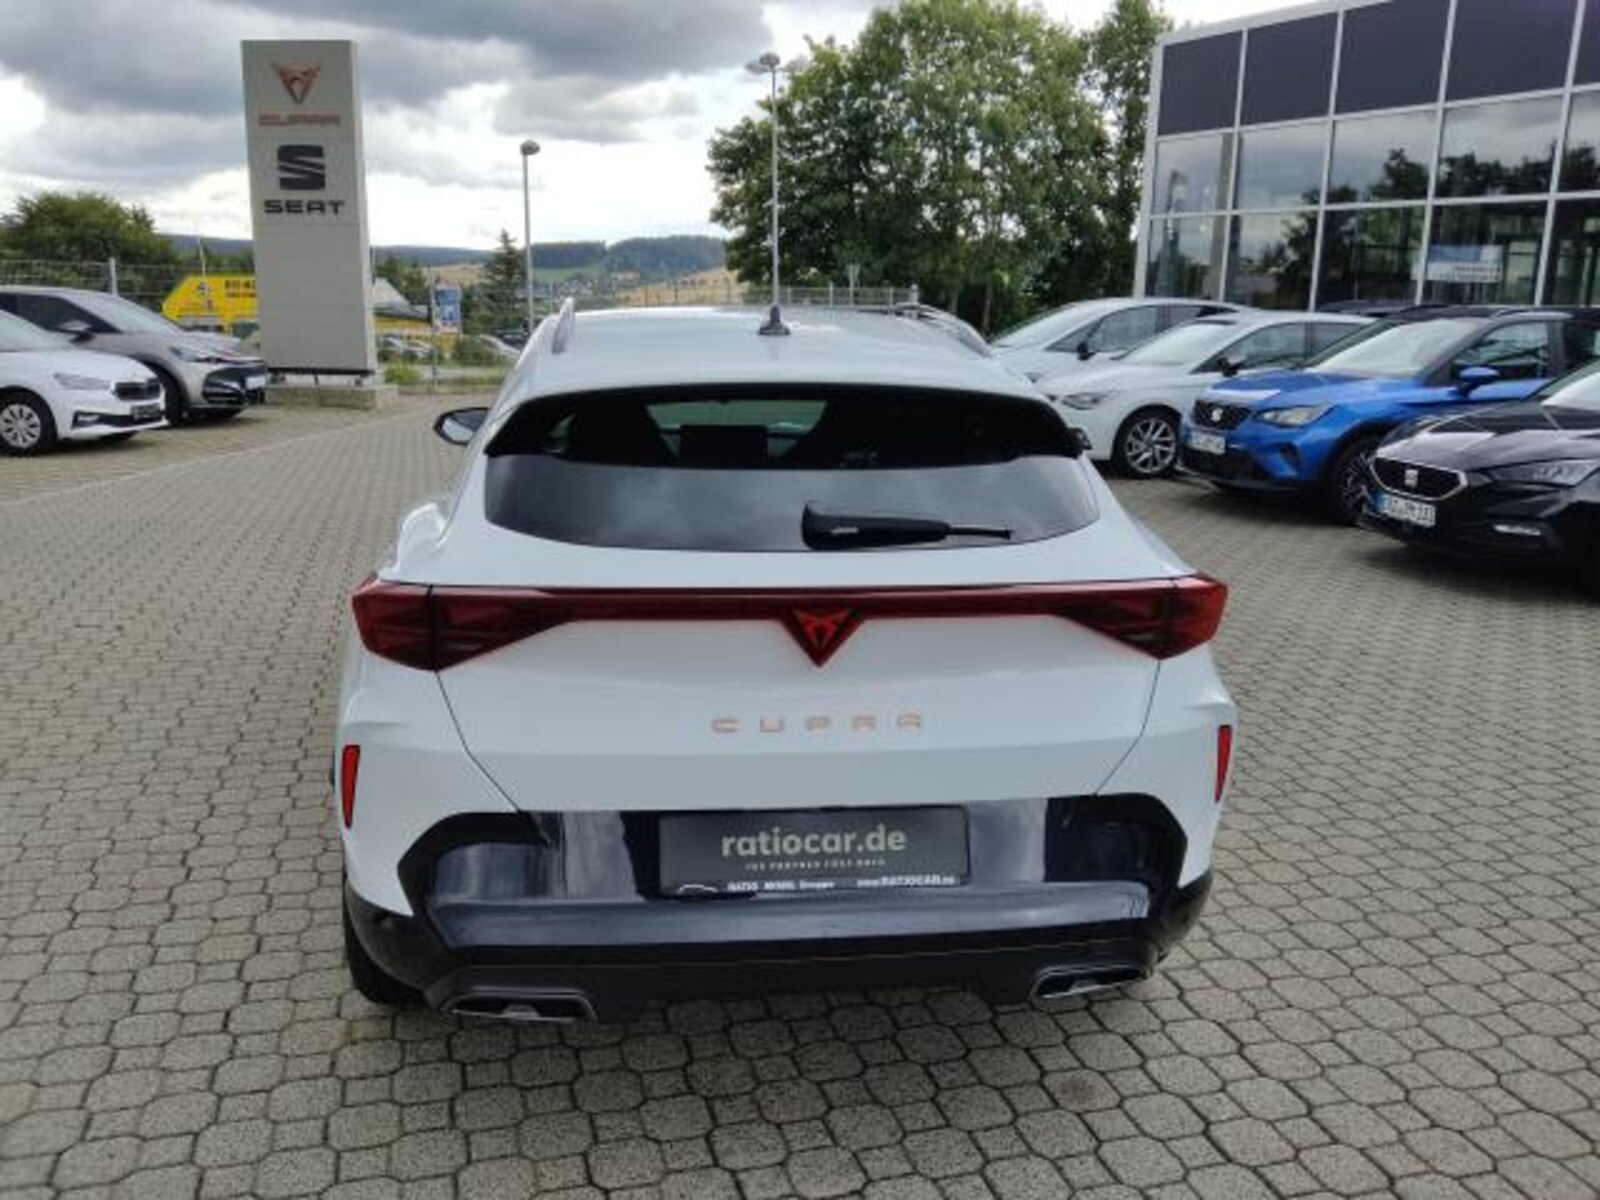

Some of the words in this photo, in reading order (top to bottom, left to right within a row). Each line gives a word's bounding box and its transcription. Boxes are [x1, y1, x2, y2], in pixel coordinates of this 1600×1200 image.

[263, 200, 345, 214] SEAT
[711, 713, 924, 734] CUPRA
[721, 824, 907, 857] ratiocar.de
